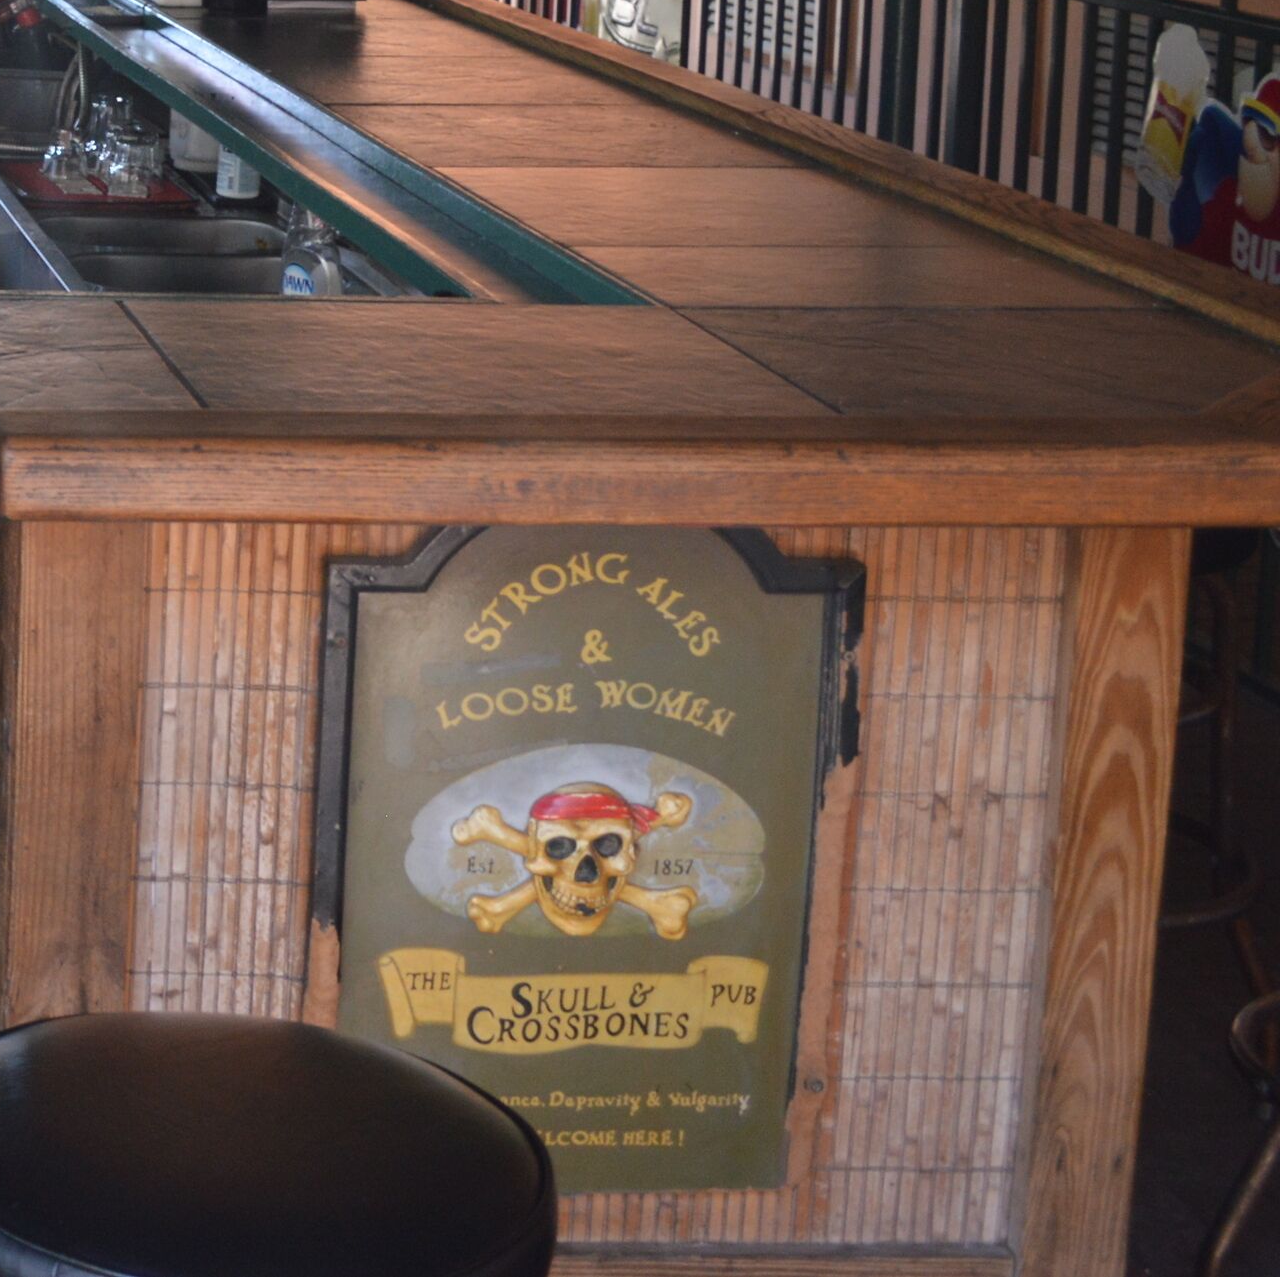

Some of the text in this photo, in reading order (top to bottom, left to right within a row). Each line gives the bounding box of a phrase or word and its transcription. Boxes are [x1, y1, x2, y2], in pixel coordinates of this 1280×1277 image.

[464, 552, 721, 658] STRONG ALES
[580, 629, 612, 665] &
[436, 679, 736, 738] LOOSE WOMEN
[653, 858, 694, 876] 1857
[405, 971, 452, 992] THE
[710, 983, 757, 1007] PUB
[511, 981, 657, 1019] SKULL &
[467, 1005, 690, 1045] CROSSBONES
[646, 1091, 661, 1108] &
